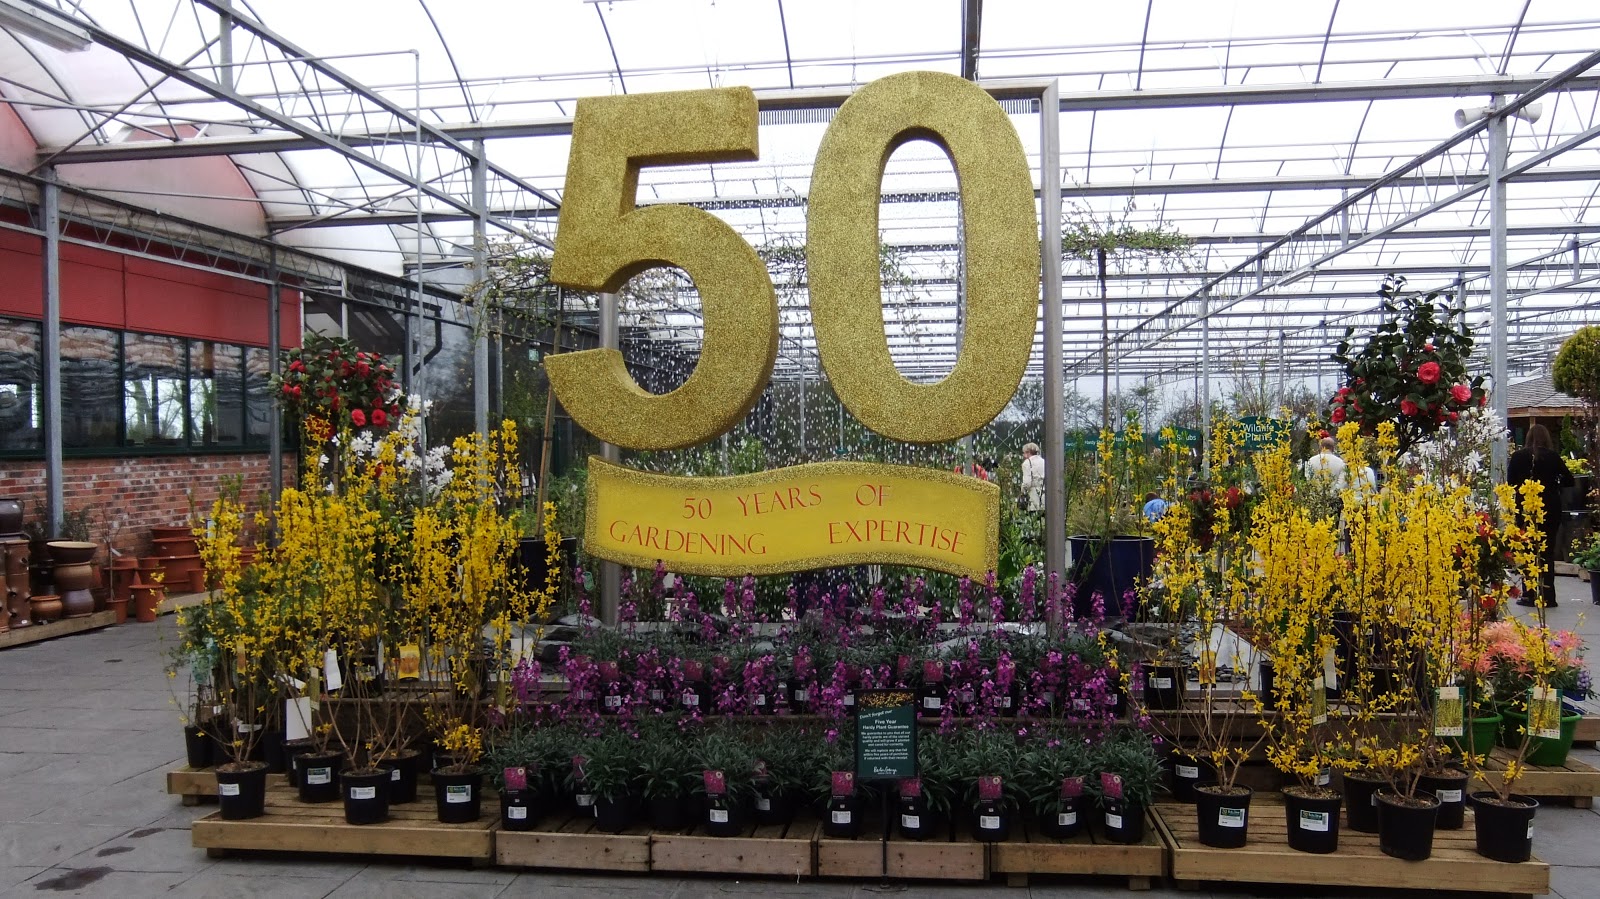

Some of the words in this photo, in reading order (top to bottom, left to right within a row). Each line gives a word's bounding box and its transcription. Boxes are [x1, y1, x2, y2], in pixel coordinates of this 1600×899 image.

[543, 70, 1041, 450] 50
[1246, 433, 1273, 441] Plnts
[682, 497, 712, 520] 50
[737, 483, 822, 518] YEARS
[855, 483, 891, 507] OF
[609, 519, 767, 556] GARDENING
[828, 519, 968, 556] EXPERTISE
